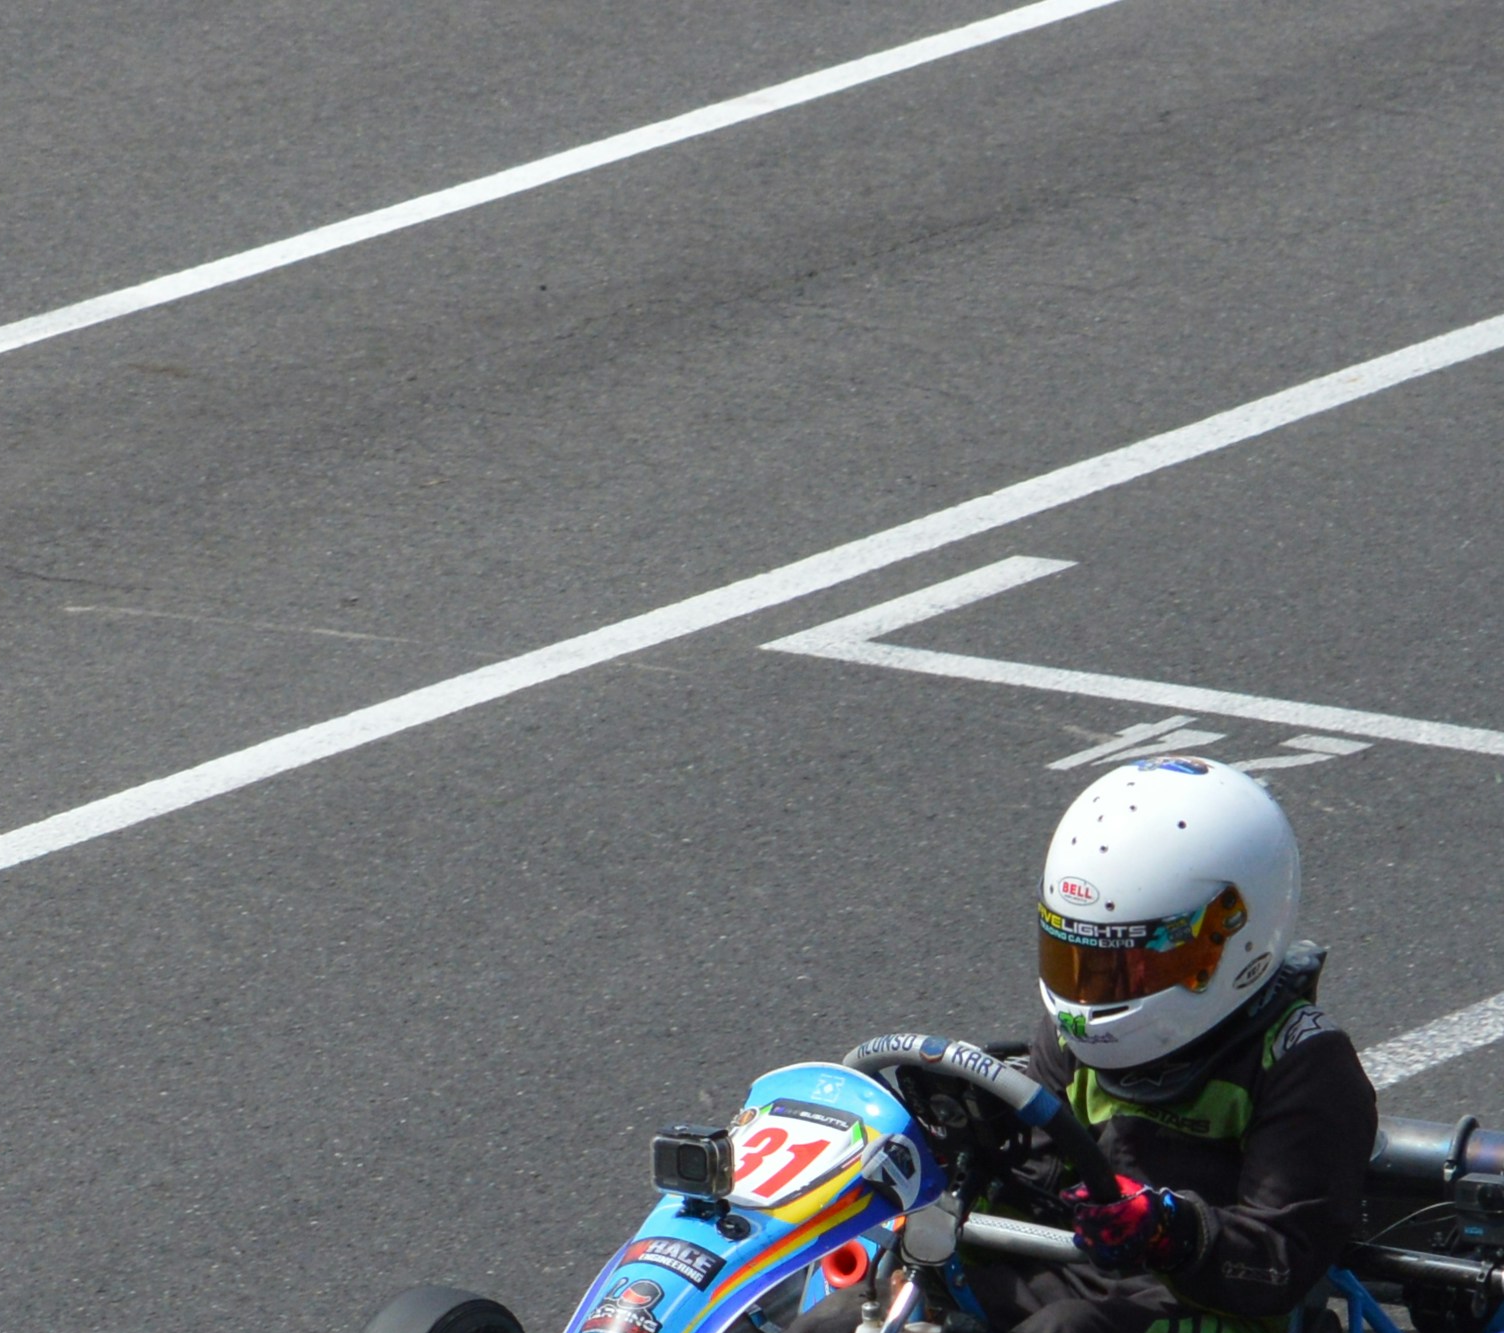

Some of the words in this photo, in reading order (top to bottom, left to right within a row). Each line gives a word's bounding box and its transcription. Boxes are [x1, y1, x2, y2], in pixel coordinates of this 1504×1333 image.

[1061, 881, 1093, 899] BELL
[1068, 934, 1097, 946] CARD
[1099, 939, 1134, 948] EXPO
[952, 1047, 1007, 1082] KART
[735, 1127, 831, 1198] 31
